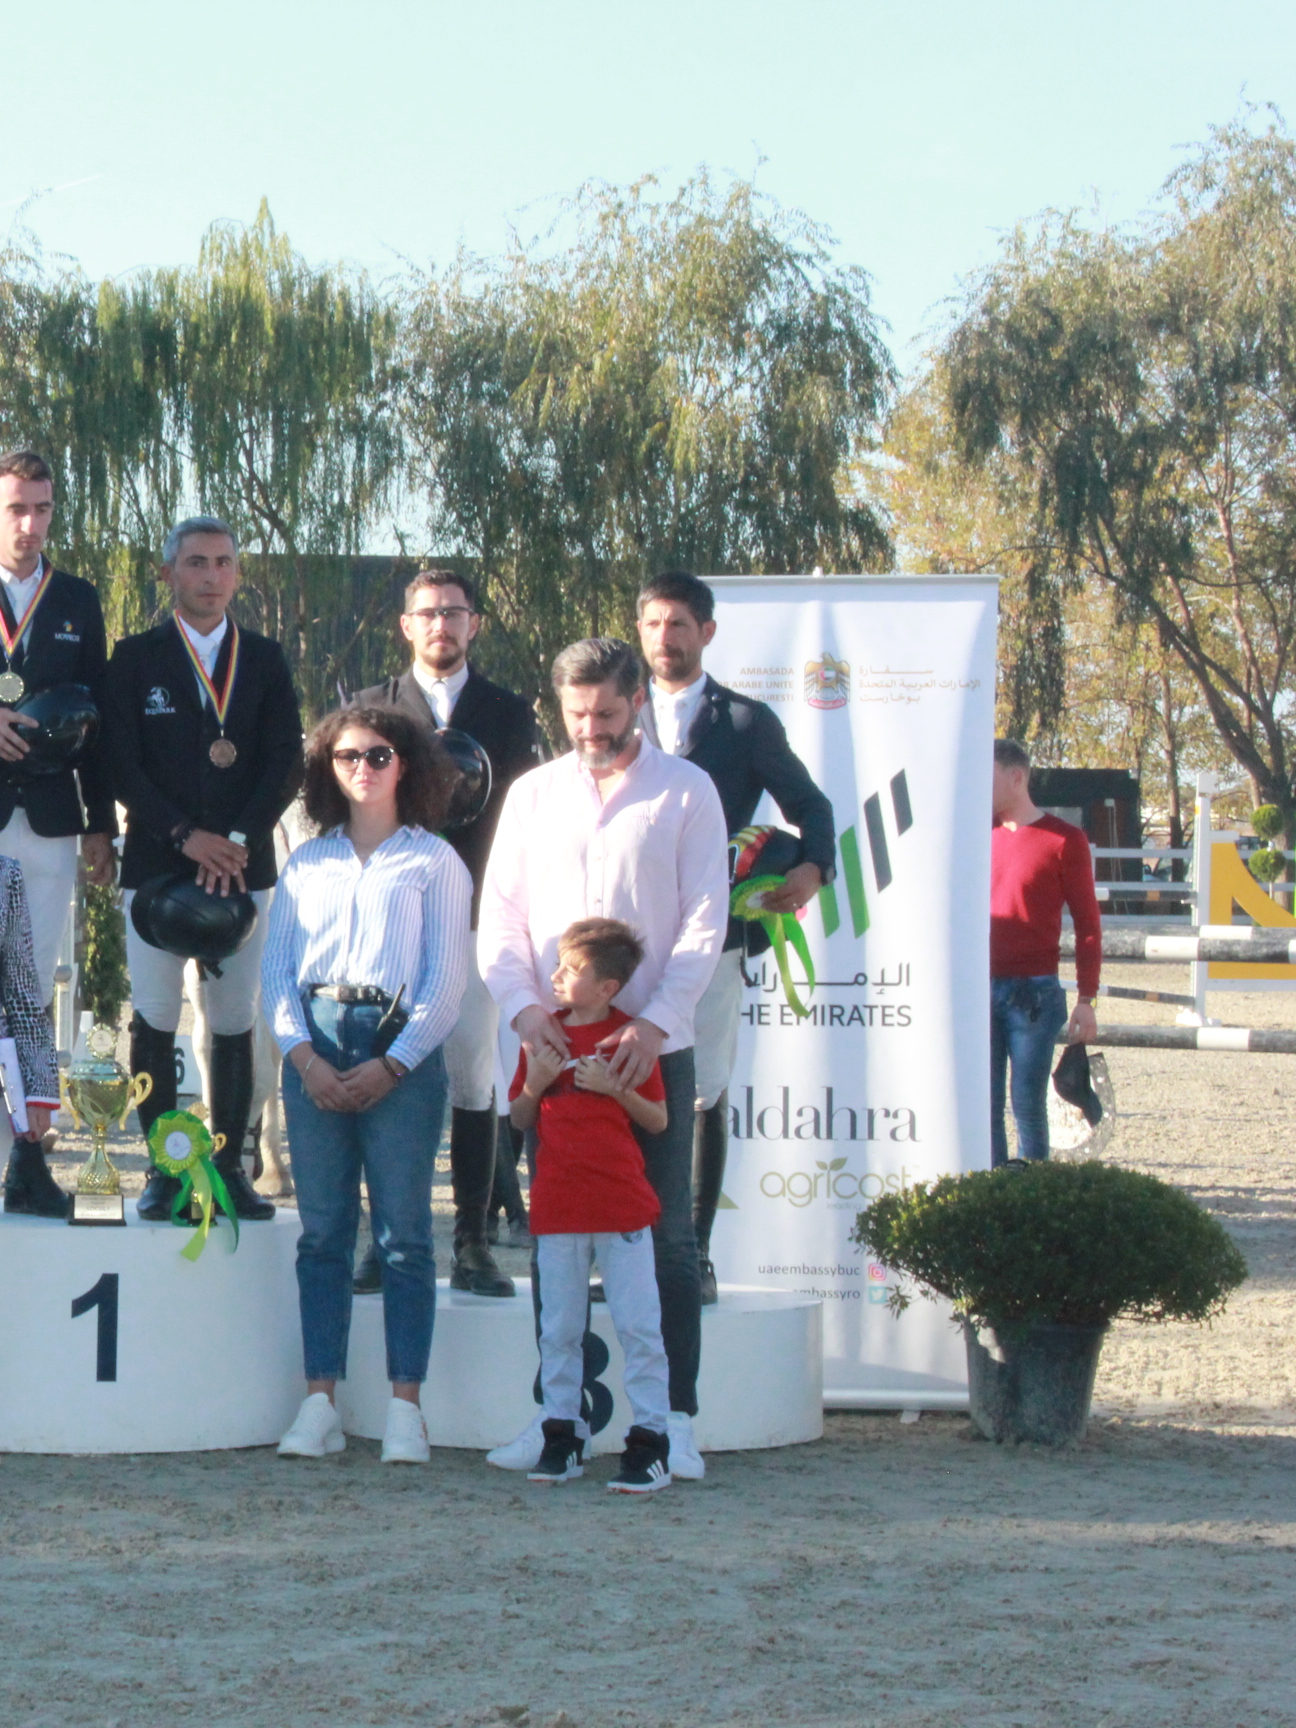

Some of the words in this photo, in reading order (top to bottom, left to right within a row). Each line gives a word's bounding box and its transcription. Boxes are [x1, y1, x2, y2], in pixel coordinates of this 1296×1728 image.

[740, 667, 794, 676] AMBASADA
[732, 680, 762, 689] ARABE
[765, 680, 794, 689] UNITE
[741, 1003, 771, 1026] HE
[780, 1003, 912, 1027] EMIRATES
[728, 1085, 922, 1142] aldahra
[758, 1263, 861, 1278] uaeembassybuc
[71, 1273, 118, 1381] 1
